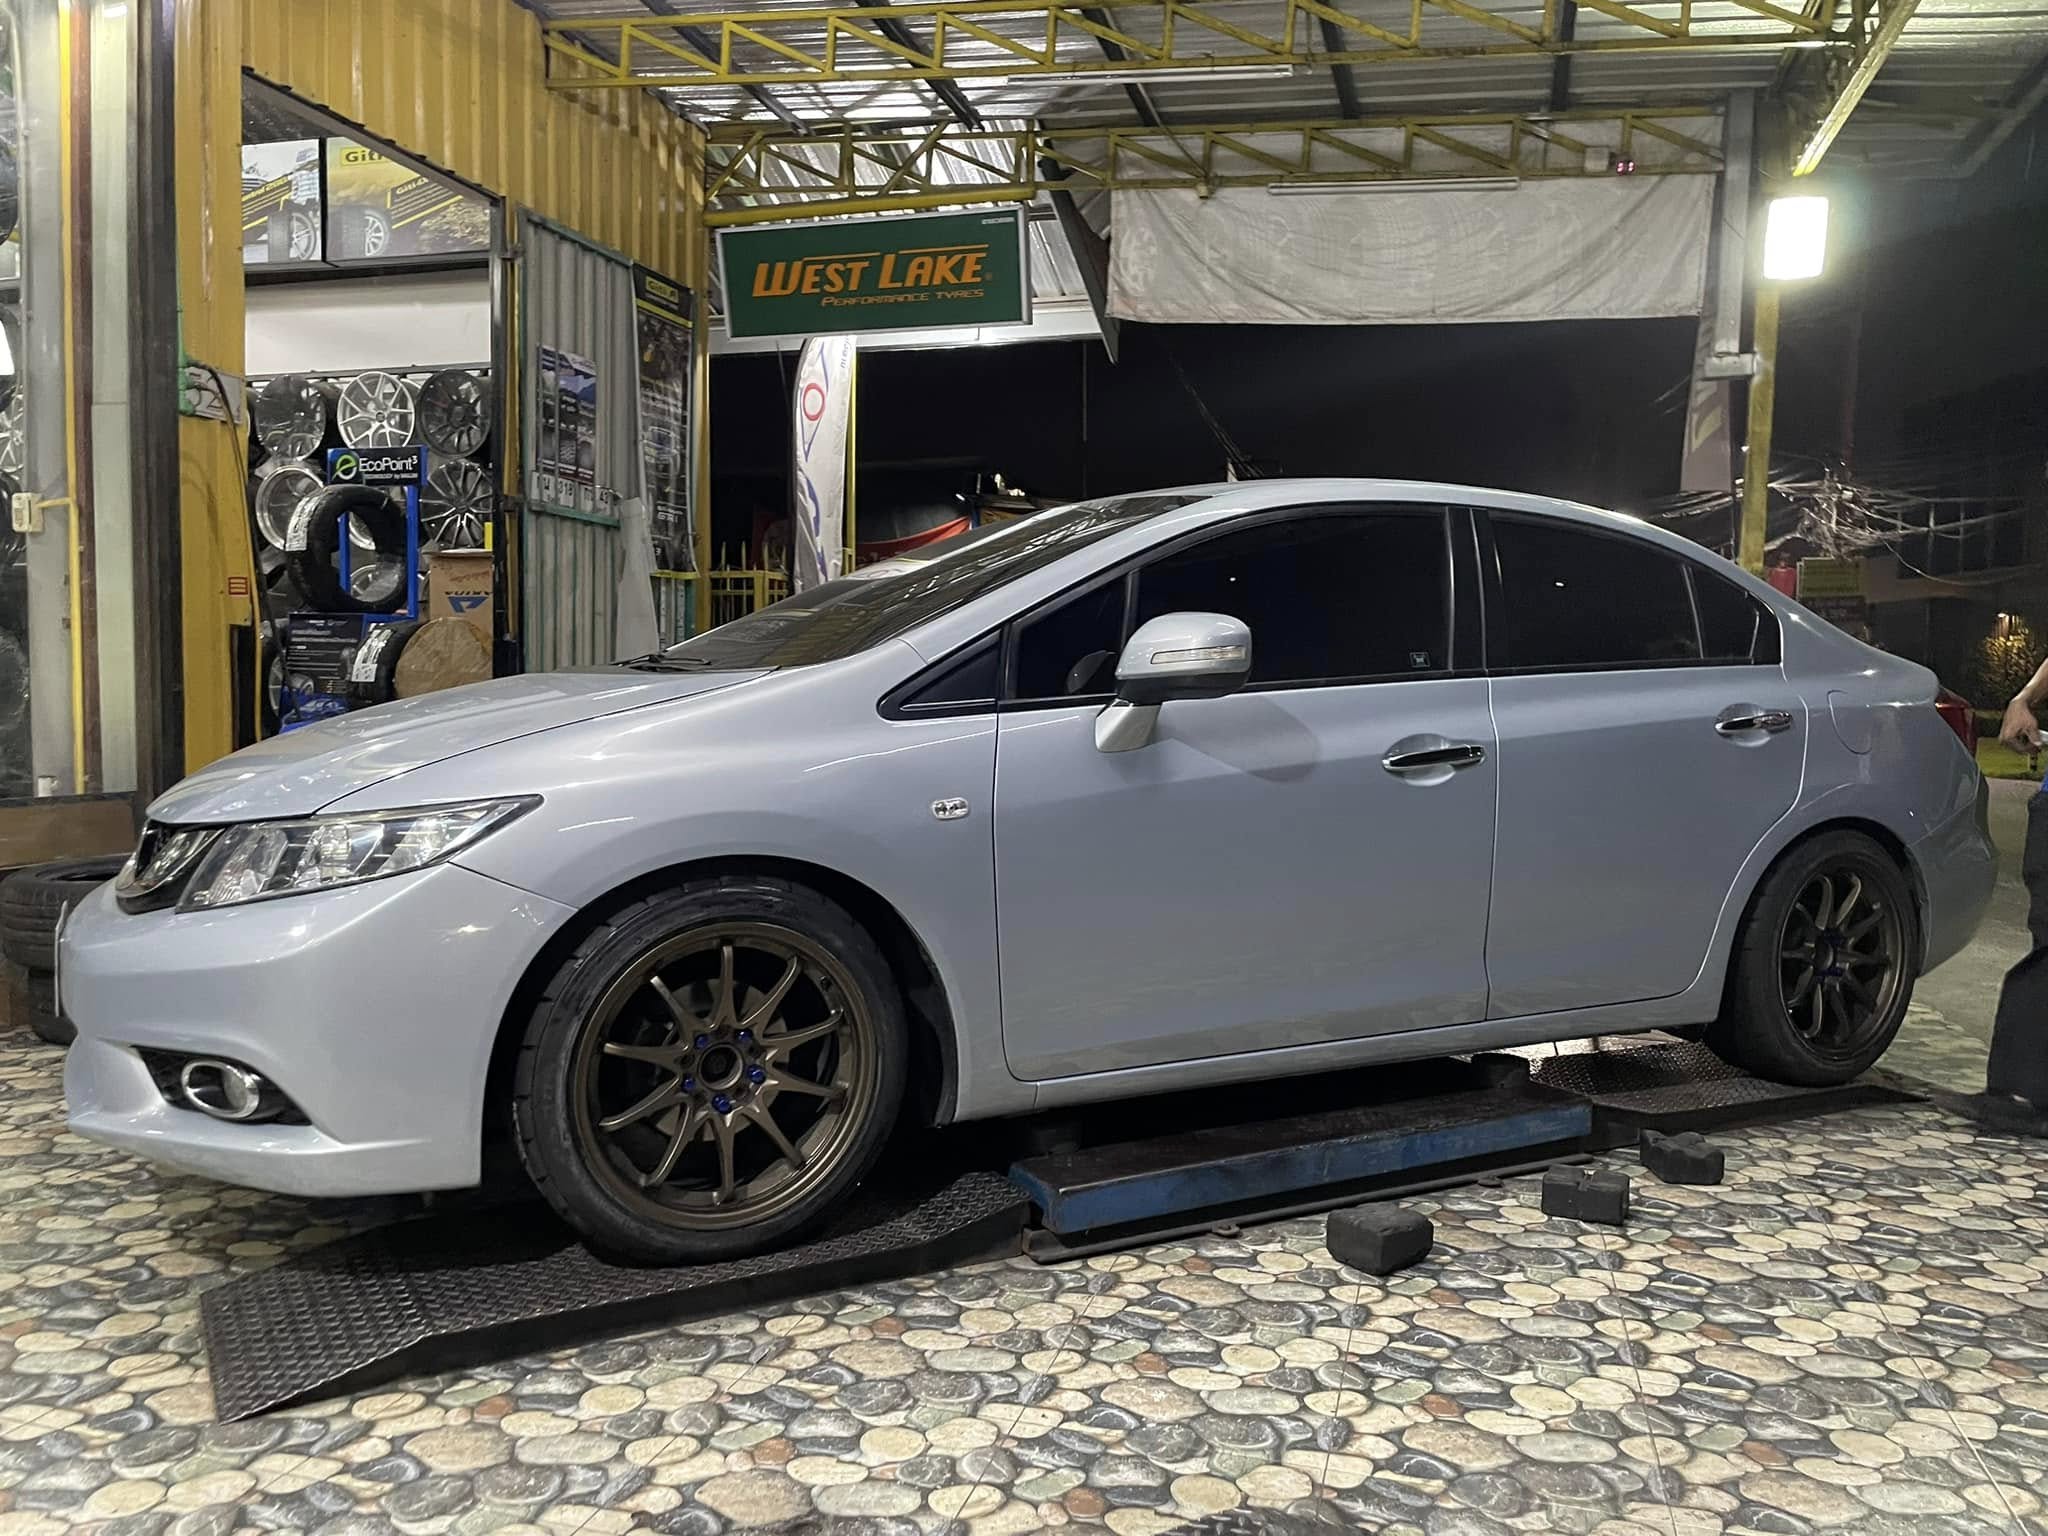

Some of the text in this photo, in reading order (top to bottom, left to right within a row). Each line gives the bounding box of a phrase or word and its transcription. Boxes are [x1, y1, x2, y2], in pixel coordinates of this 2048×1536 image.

[752, 252, 988, 297] WEST LAKE
[821, 289, 985, 307] PERFORMANCE TYRES
